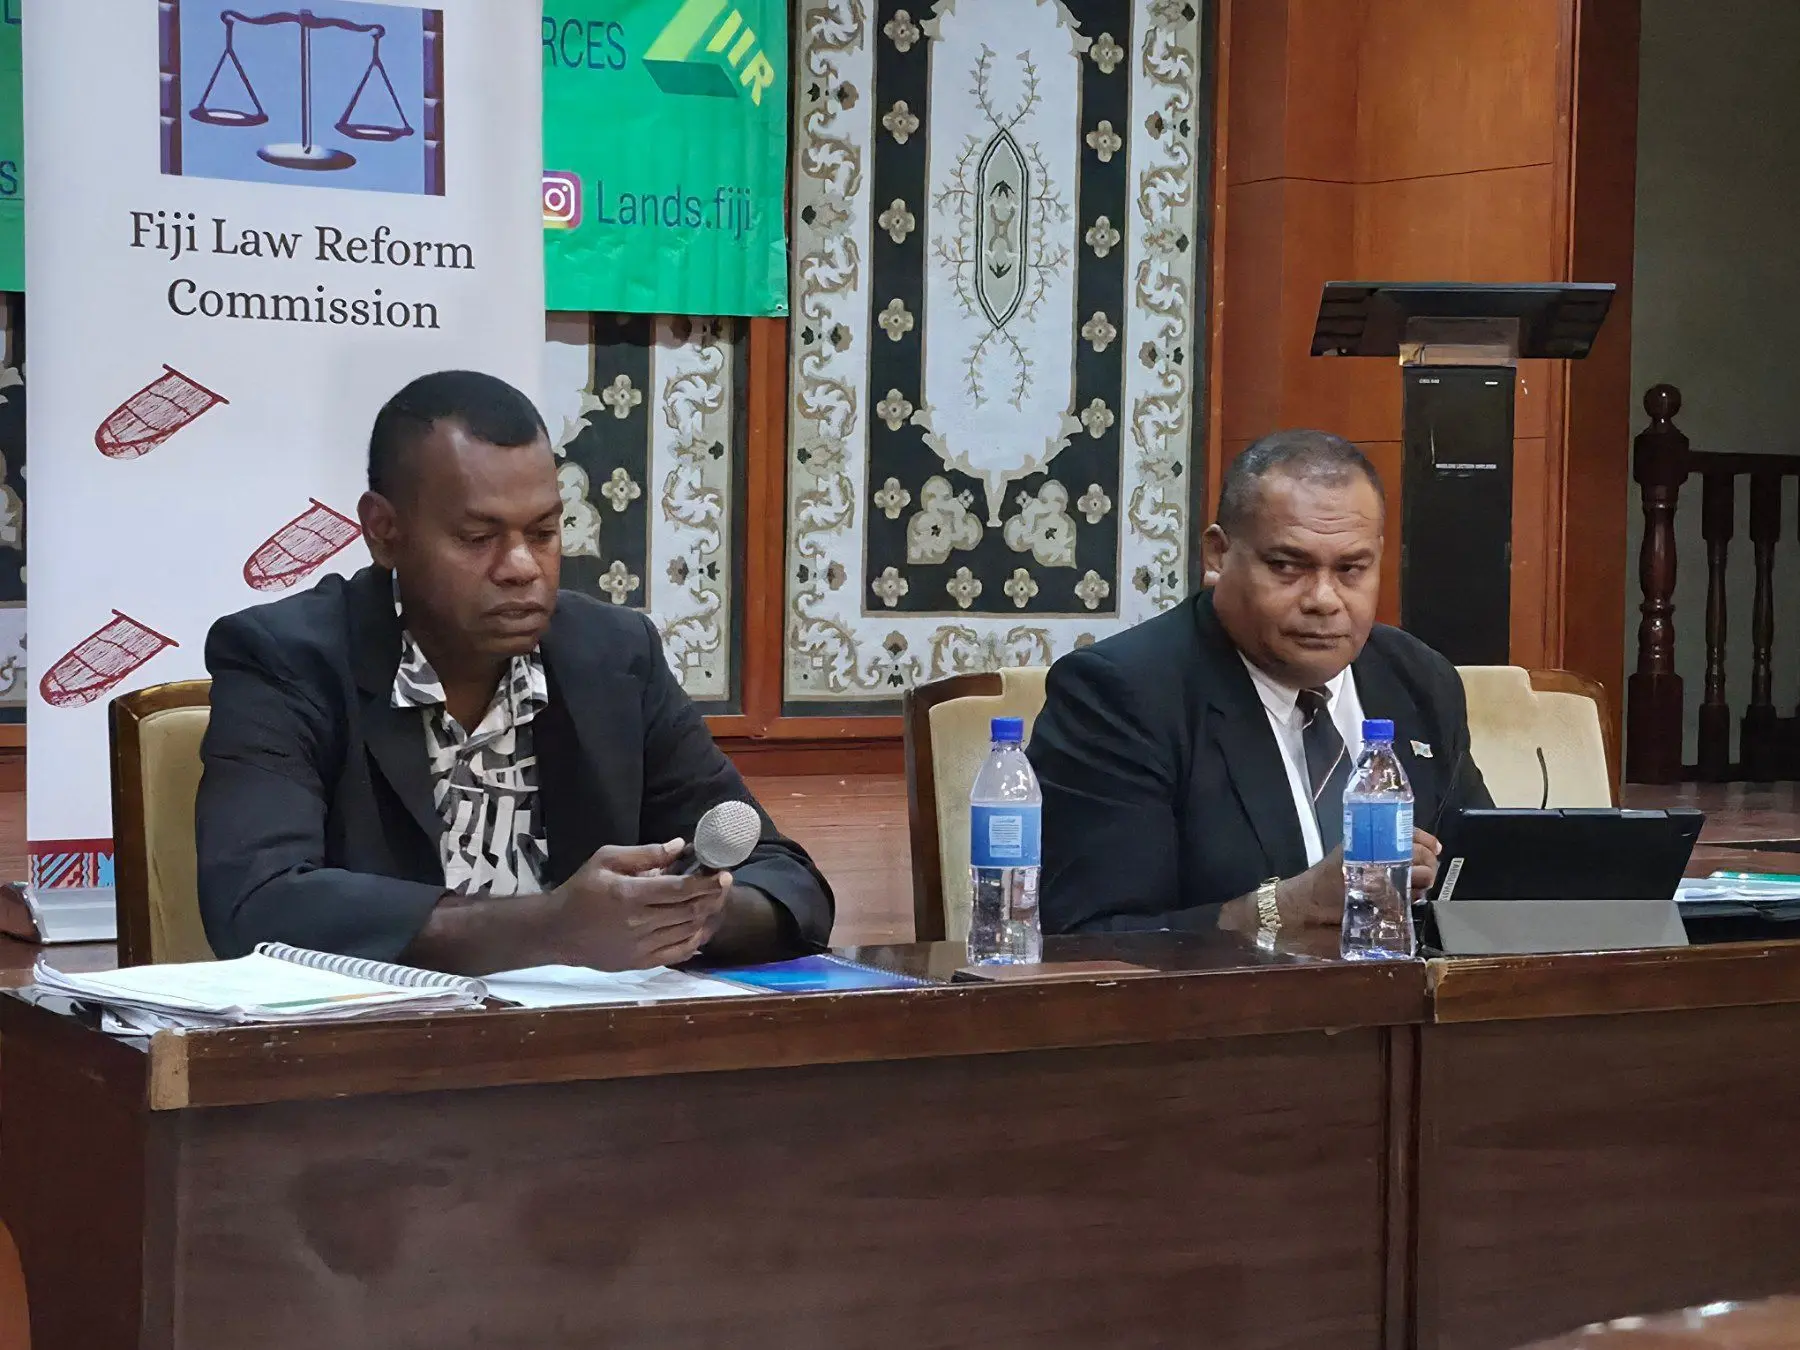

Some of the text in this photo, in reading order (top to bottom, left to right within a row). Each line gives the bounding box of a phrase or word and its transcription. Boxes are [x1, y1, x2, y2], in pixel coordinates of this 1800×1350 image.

[597, 179, 752, 240] Lands.fiji
[130, 210, 476, 269] Fiji Law Reform
[168, 278, 441, 329] Commission
